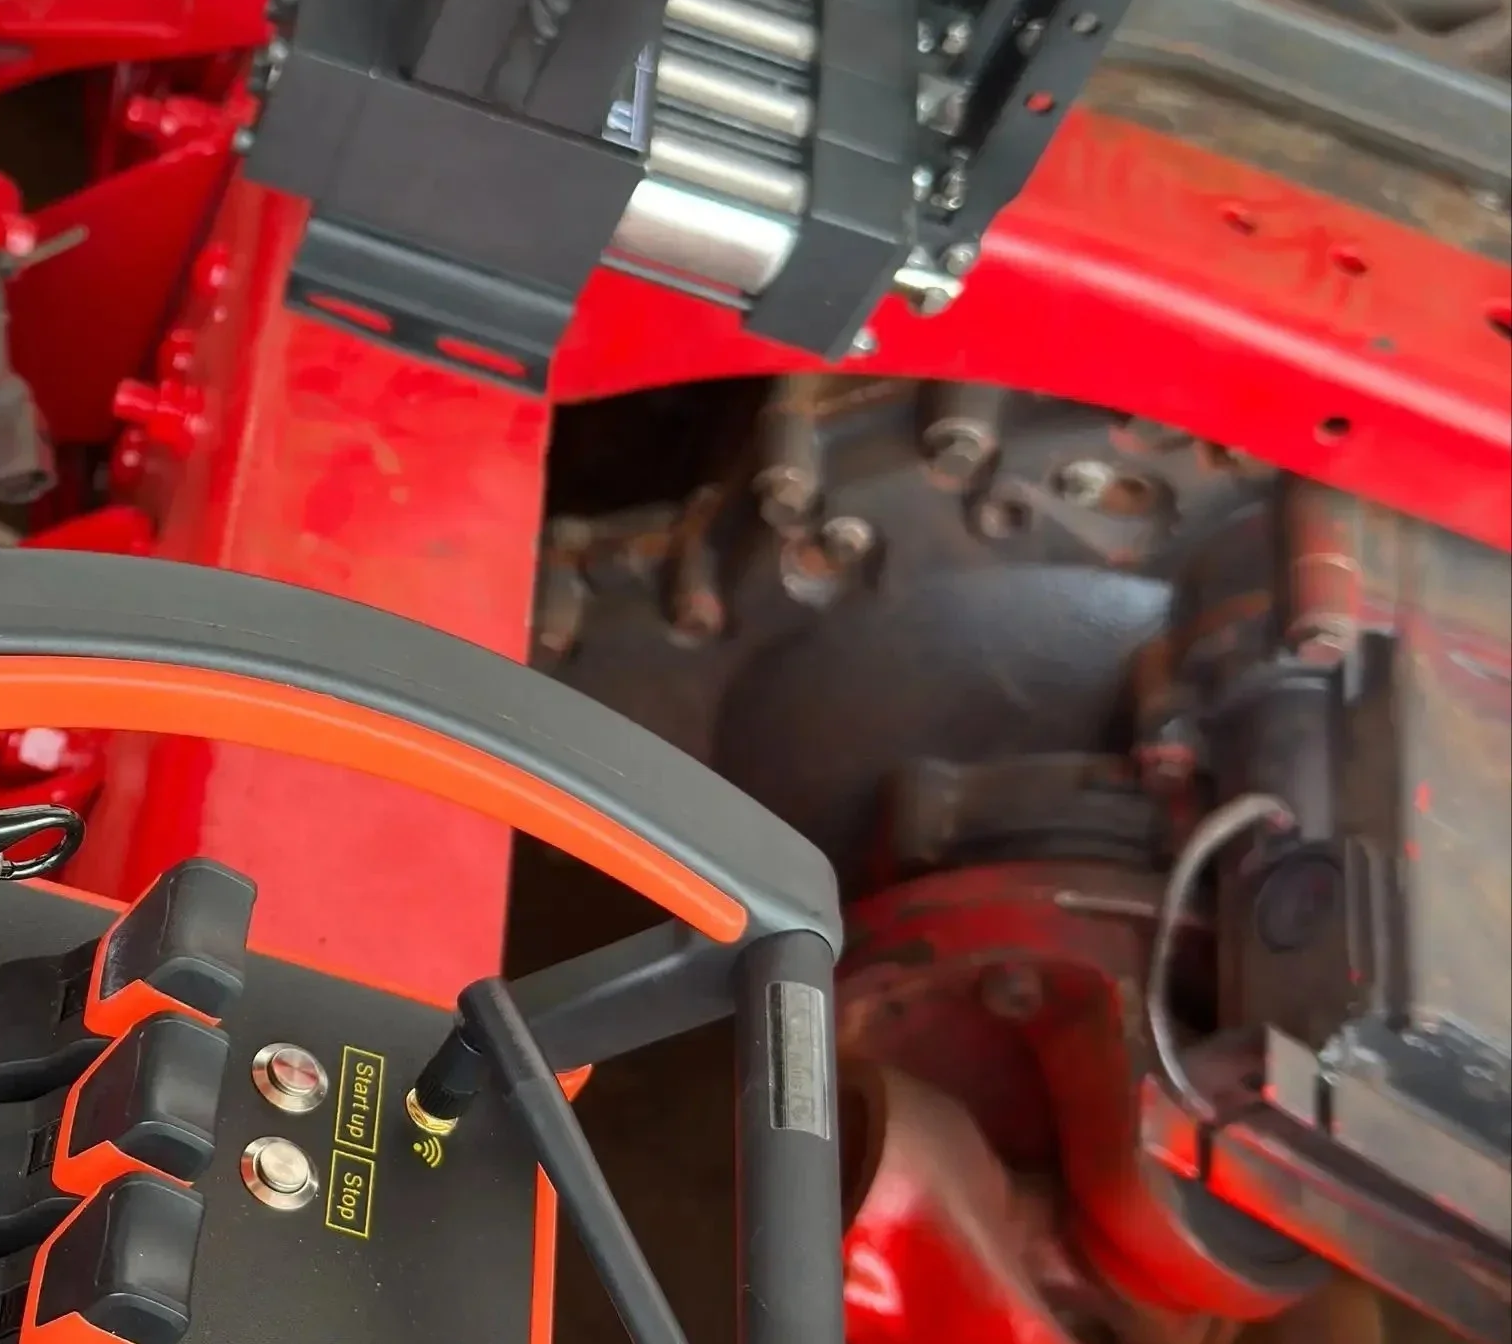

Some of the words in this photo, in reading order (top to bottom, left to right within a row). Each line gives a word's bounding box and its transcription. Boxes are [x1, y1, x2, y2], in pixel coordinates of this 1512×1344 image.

[353, 1062, 375, 1111] Start
[345, 1112, 367, 1139] up
[337, 1171, 364, 1221] Stop
